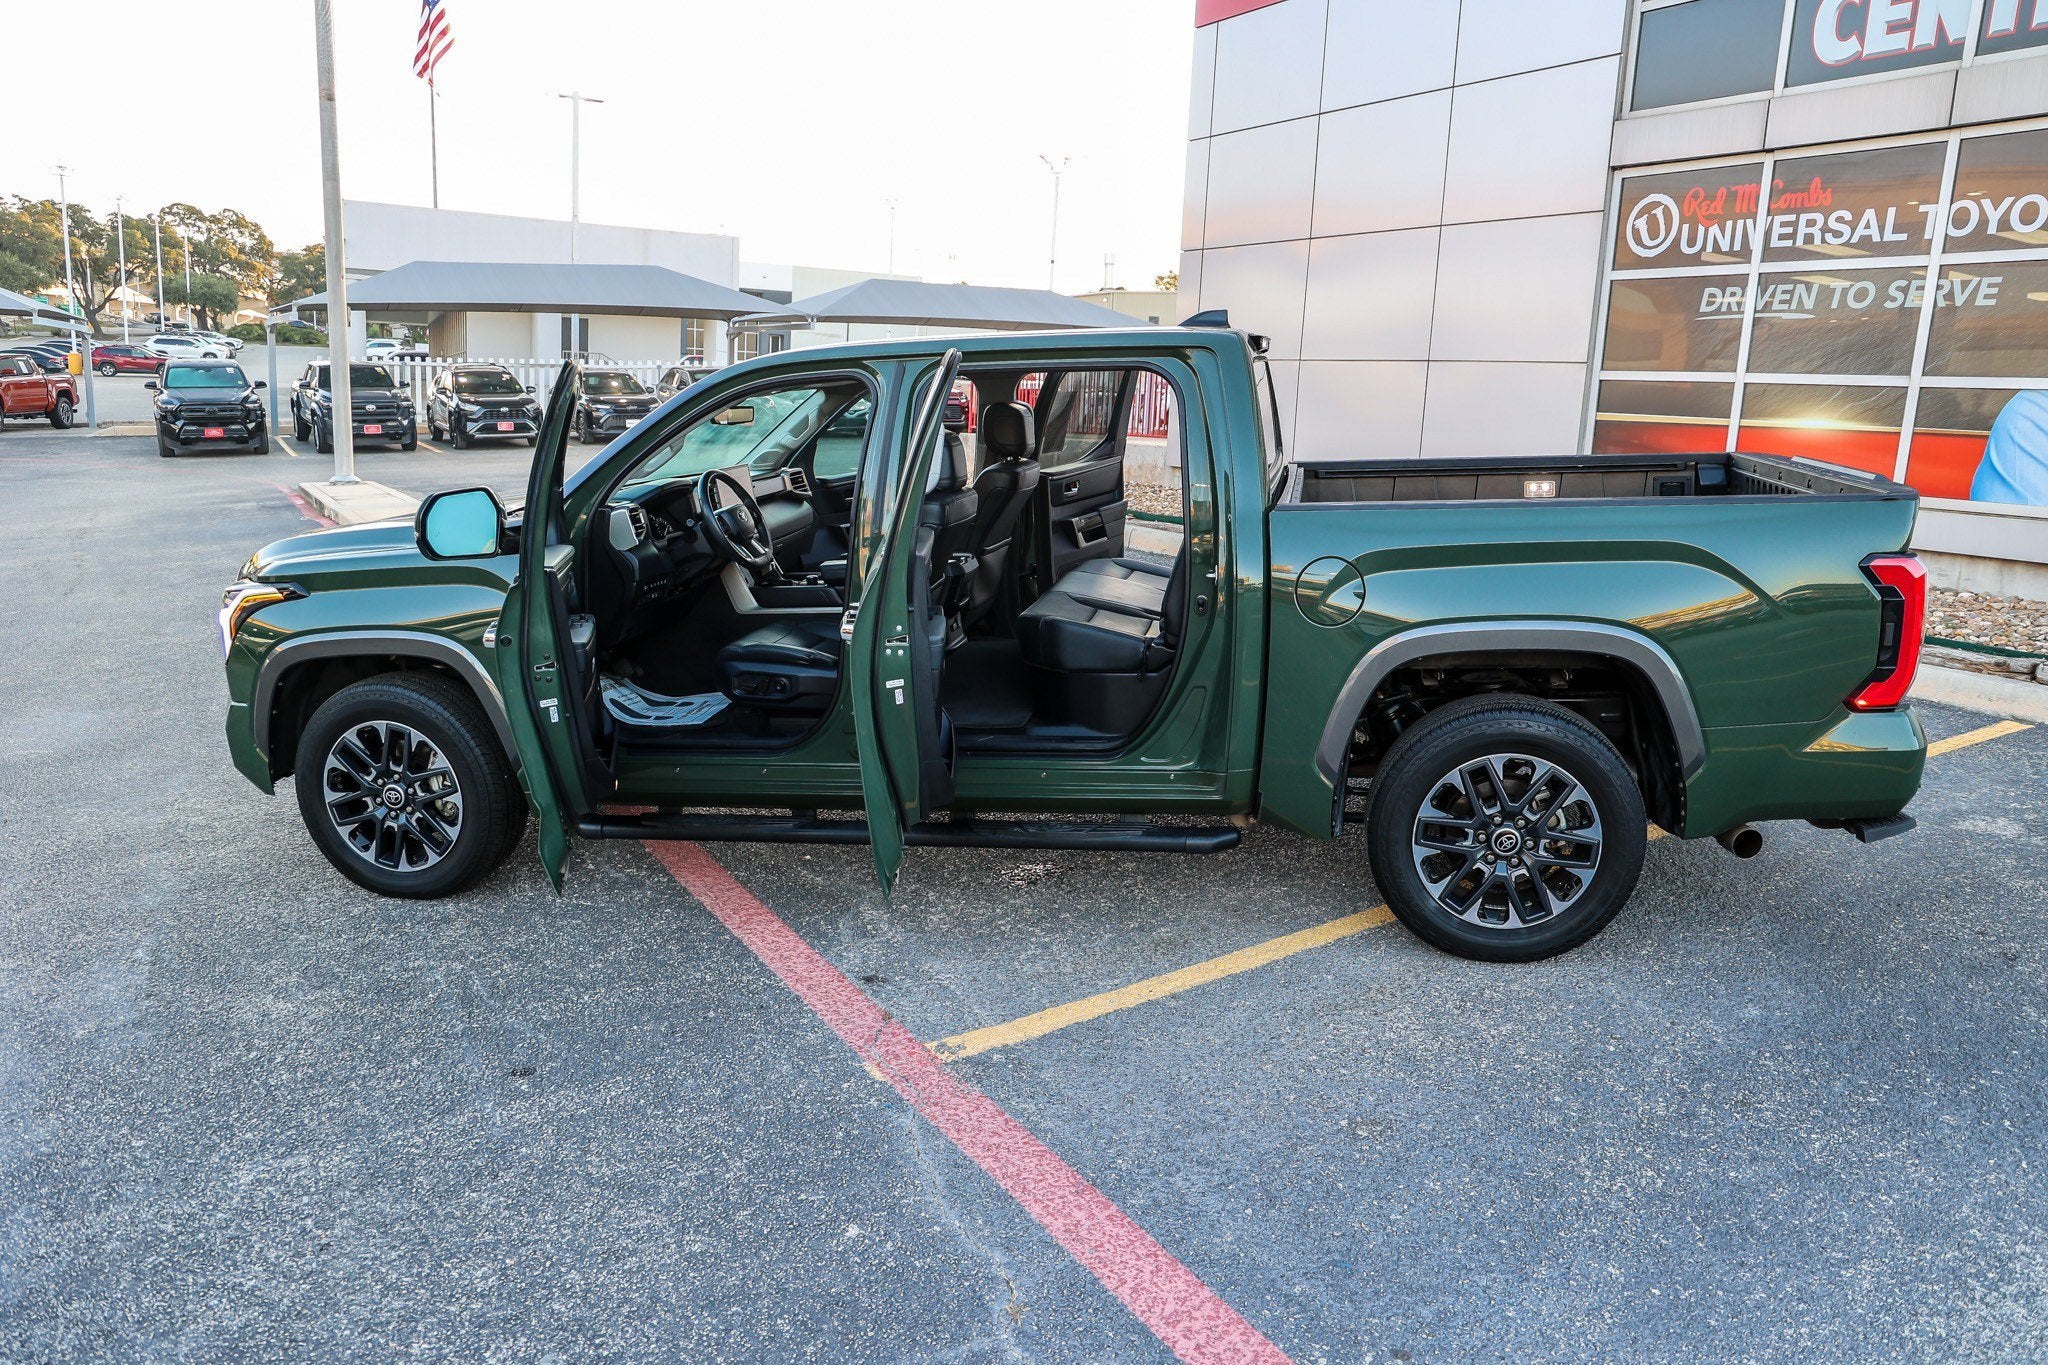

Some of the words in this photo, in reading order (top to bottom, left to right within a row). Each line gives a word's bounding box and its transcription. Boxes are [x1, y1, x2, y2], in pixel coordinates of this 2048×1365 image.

[1682, 186, 1727, 227] Red
[1680, 207, 1908, 254] UNIVERSAL
[1699, 284, 1819, 312] DRIVEN
[1830, 281, 1876, 309] TO
[1884, 276, 2003, 308] SERVE
